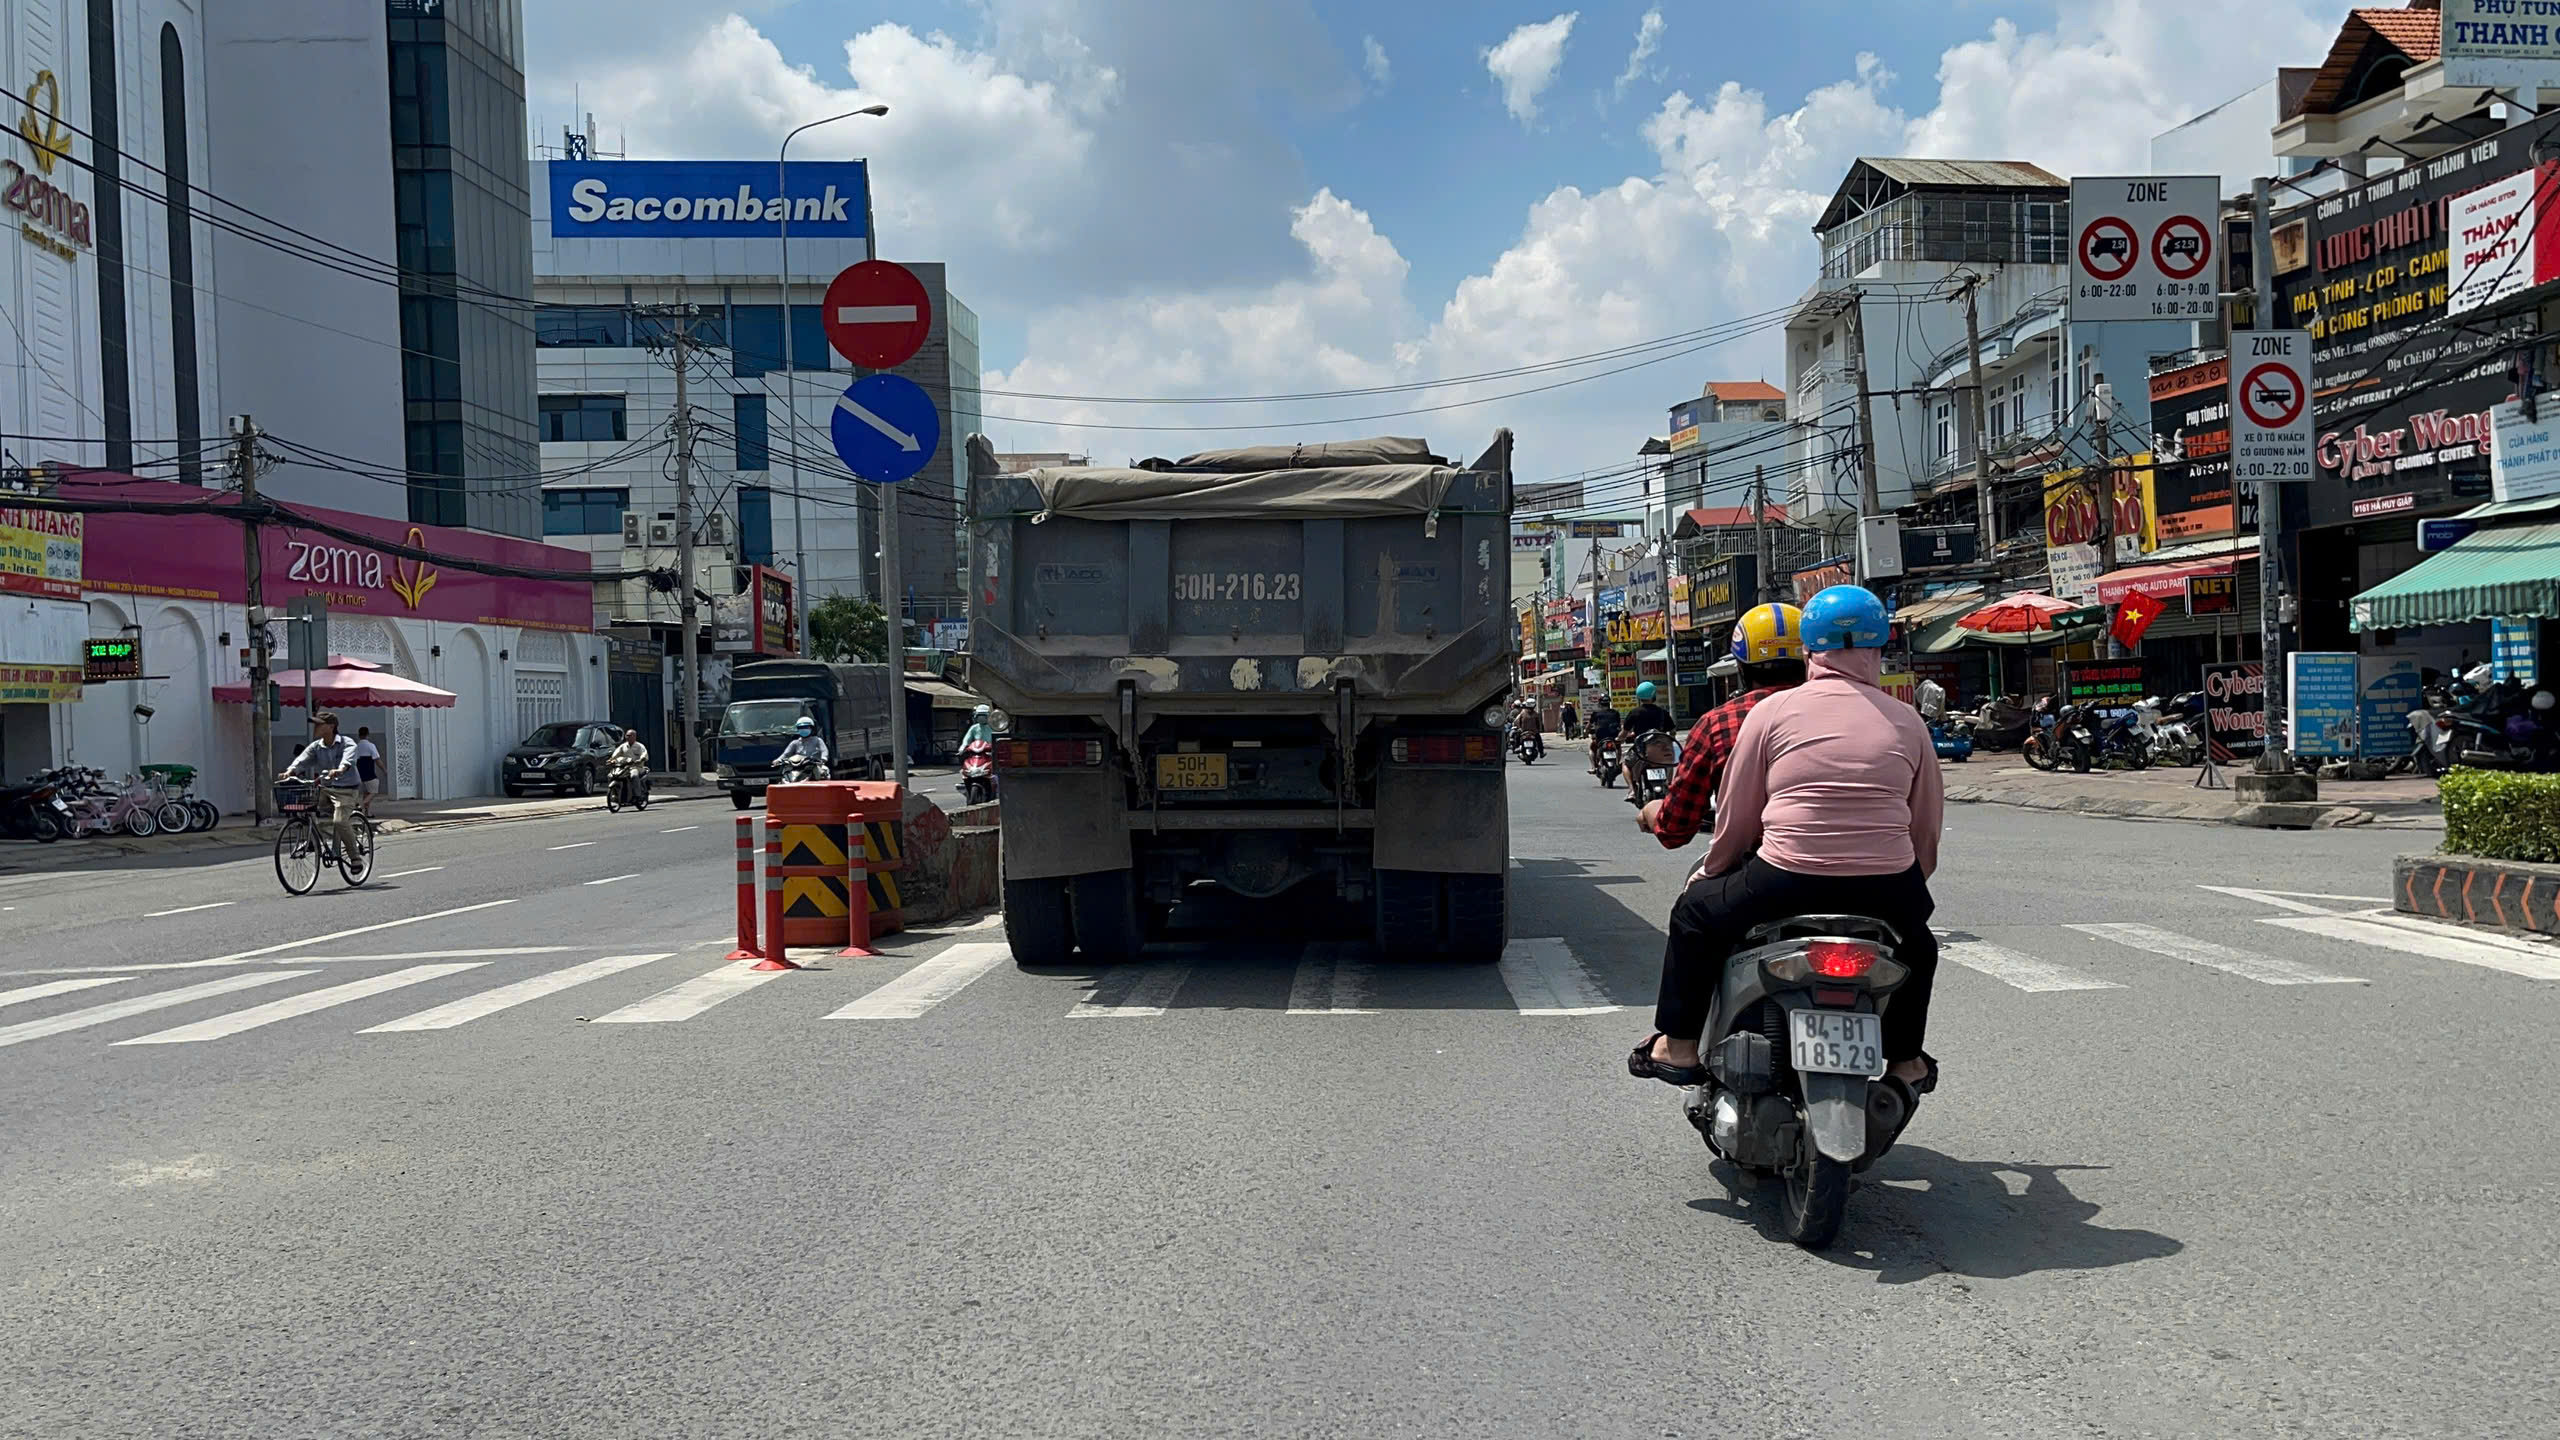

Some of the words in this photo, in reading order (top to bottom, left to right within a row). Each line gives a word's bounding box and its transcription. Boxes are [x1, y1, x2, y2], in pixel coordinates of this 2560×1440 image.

[2127, 182, 2168, 203] ZONE
[2317, 198, 2343, 221] CÔNG
[2348, 193, 2361, 210] TY
[2366, 182, 2394, 202] TNHH
[2399, 167, 2422, 191] MỘT
[2427, 150, 2466, 181] THÀNH
[2471, 140, 2498, 166] VIÊN
[568, 178, 851, 223] Sacombank
[2462, 212, 2521, 245] THÀNH
[2316, 223, 2372, 273] LONG
[2252, 336, 2292, 356] ZONE
[2244, 433, 2255, 442] XE
[2278, 430, 2305, 442] KHÁCH
[2317, 424, 2405, 478] Cyber
[2409, 408, 2492, 455] Wong
[2395, 451, 2435, 471] GAMING
[2438, 444, 2475, 463] CENTER
[2382, 499, 2396, 510] HUY
[1175, 572, 1300, 600] 50H-216.23
[2149, 580, 2168, 591] AUTO
[2193, 577, 2232, 595] NET
[91, 645, 106, 657] XE
[109, 644, 131, 657] ĐẠP
[2207, 669, 2264, 703] Cyber
[2209, 706, 2265, 738] Wong
[1177, 756, 1207, 771] 50H
[1166, 773, 1219, 787] 216.23
[1805, 1014, 1864, 1042] 84-B1
[1797, 1041, 1876, 1070] 185.29
